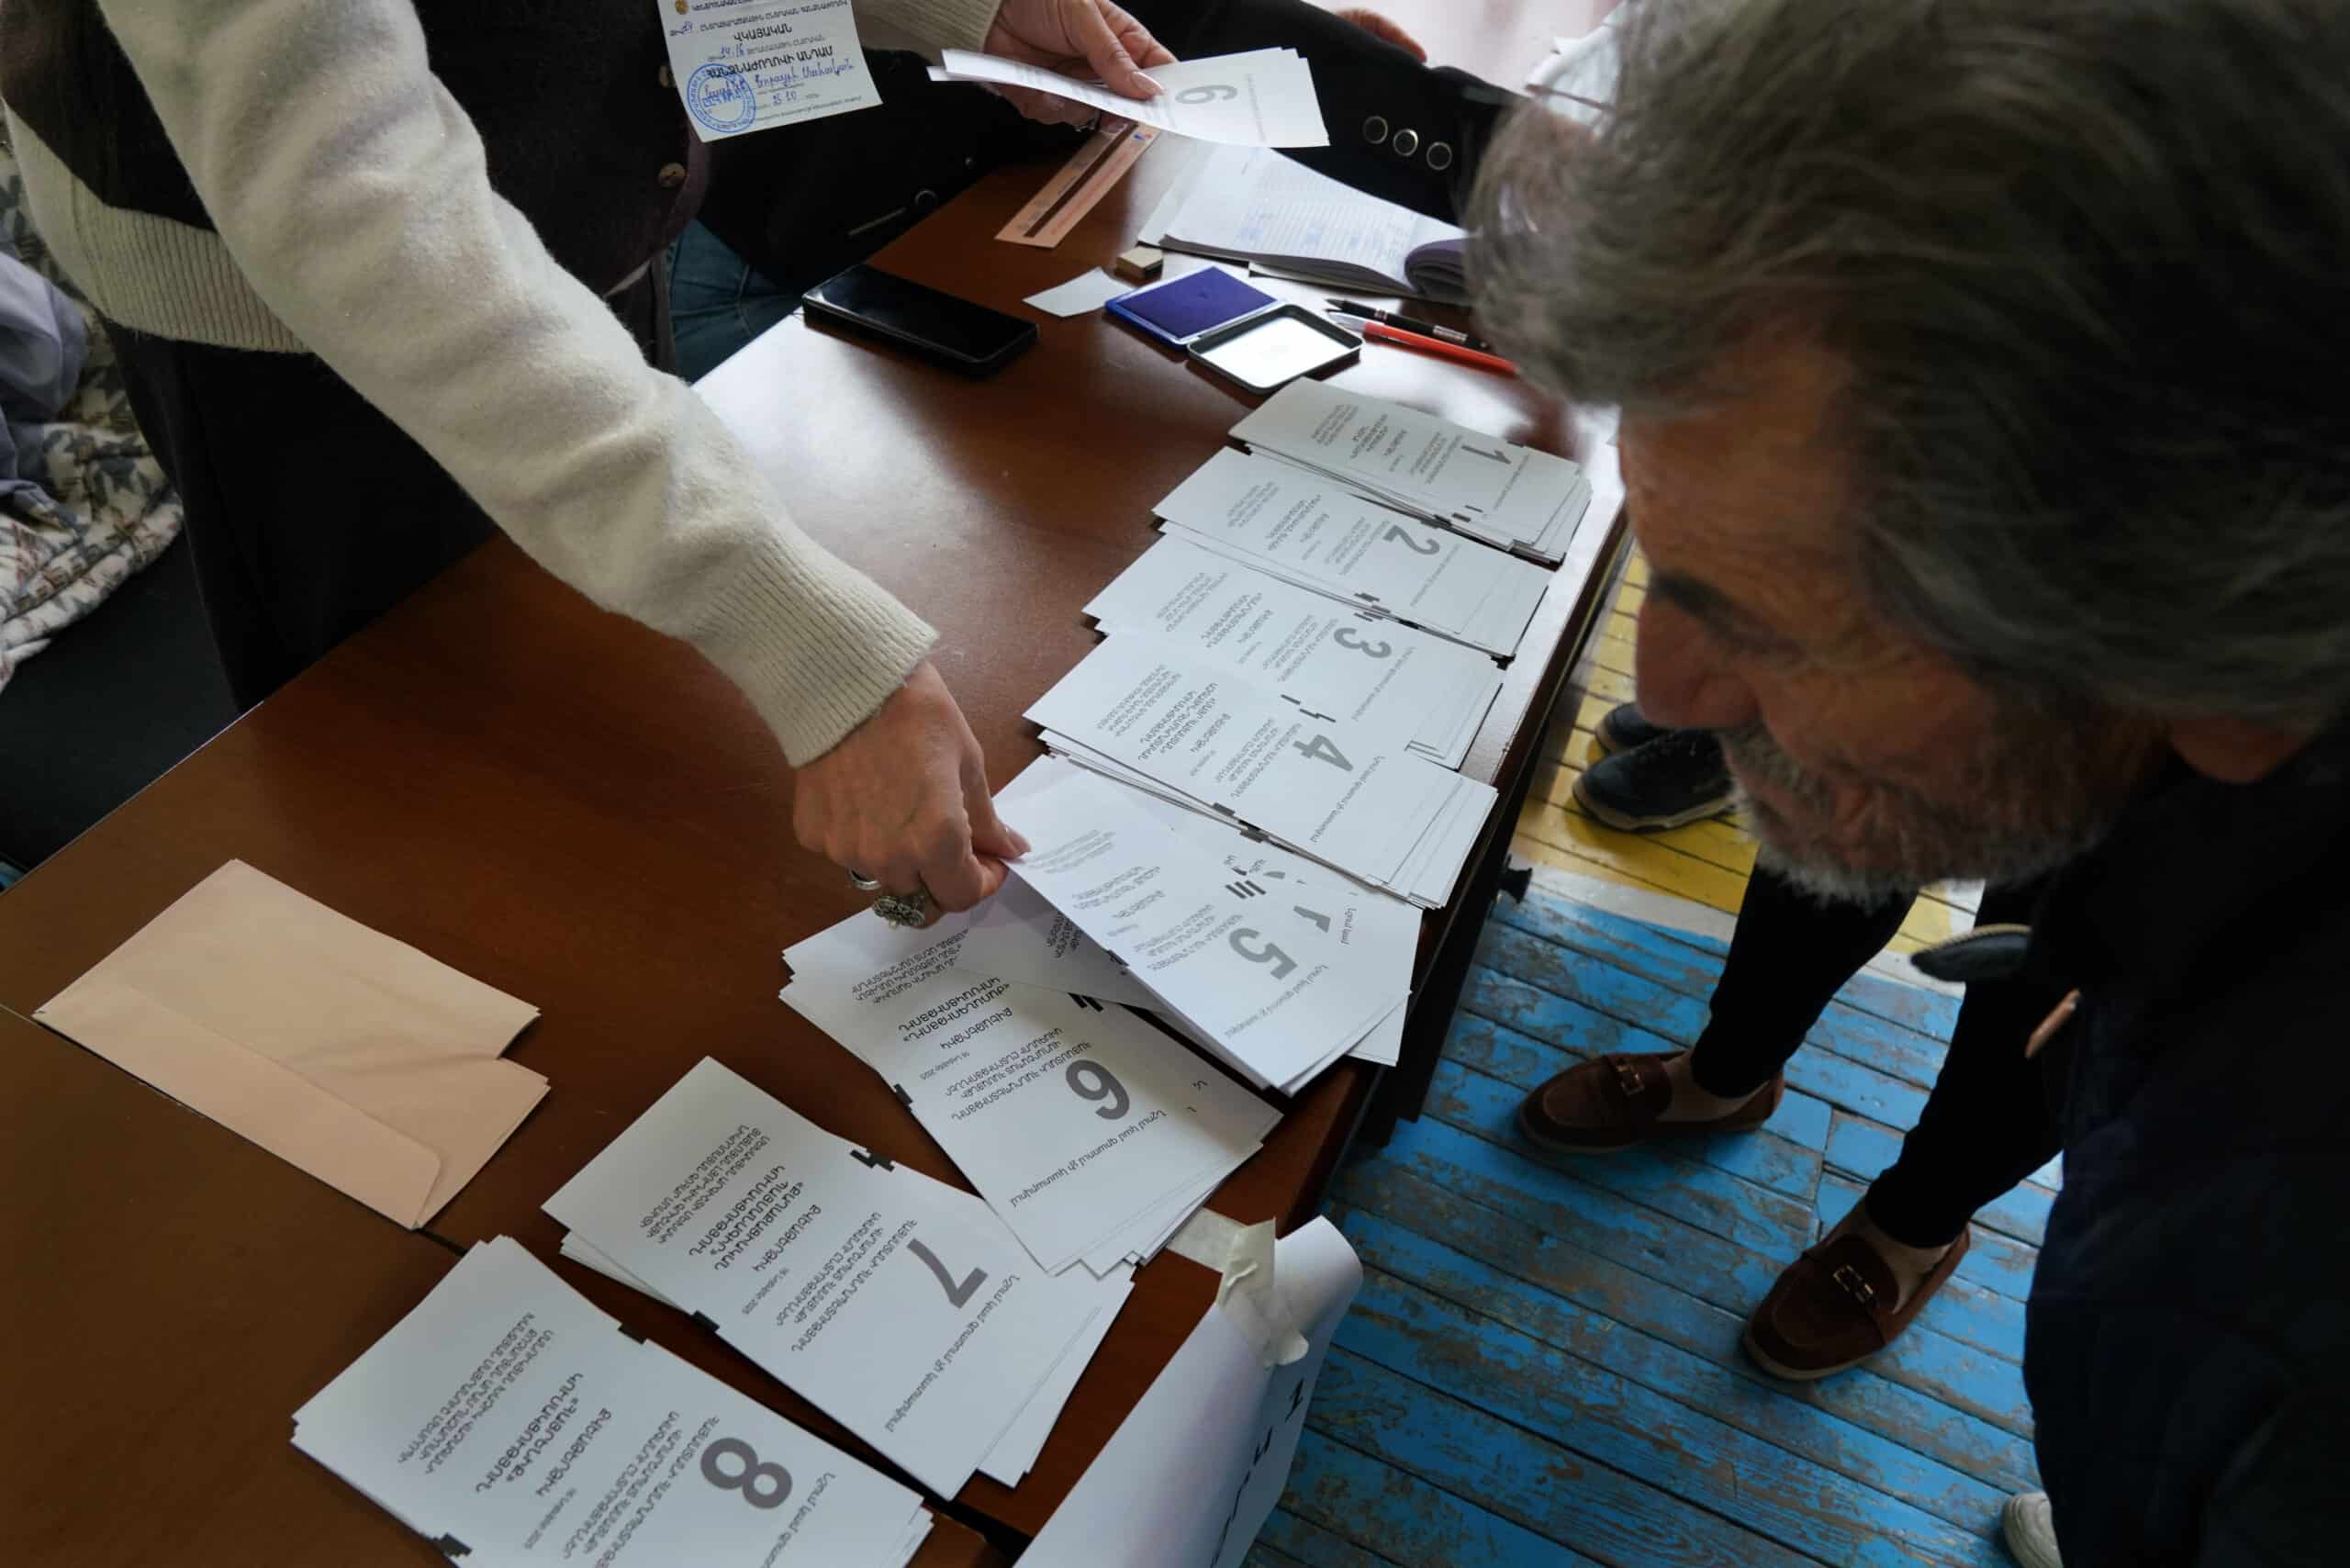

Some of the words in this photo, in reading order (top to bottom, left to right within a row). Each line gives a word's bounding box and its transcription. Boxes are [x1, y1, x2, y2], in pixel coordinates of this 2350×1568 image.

[733, 23, 793, 41] ՎԿԱՅԱԿԱՆ
[798, 45, 834, 62] ԱՆԴԱՄ
[1460, 445, 1511, 465] 1
[1383, 524, 1440, 555] 2
[1334, 627, 1392, 658] 3
[1293, 734, 1353, 772] 4
[1229, 927, 1298, 980] 5
[898, 976, 1001, 1031] ԿՈՒՍԱԿՑՈՒԹՅՈՒՆ
[903, 982, 1011, 1042] «ԺԱՌԱՆԳՈՒԹՅՈՒՆ»
[940, 1003, 1013, 1049] ՔՎԵԱԹԵՐԹԻԿ
[1065, 1058, 1130, 1120] 6
[1138, 1103, 1169, 1130] Նշում
[688, 1165, 786, 1256] ԿՈՒՍԱԿՑՈՒԹՅՈՒՆ
[710, 1182, 789, 1255] ՊԱՅՄԱՆԱԳԻՐ»
[714, 1182, 803, 1271] «ՔԱՂԱՔԱՑԻԱԿԱՆ
[752, 1204, 822, 1271] ՔՎԵԱԹԵՐԹԻԿ
[869, 1220, 917, 1269] ՀԱՅԱՍՏԱՆԻ
[907, 1238, 989, 1309] 7
[993, 1274, 1021, 1304] Նշում
[791, 1269, 873, 1351] ՀԱՆՐԱՊԵՏՈՒԹՅՈՒՆ
[977, 1301, 998, 1323] կամ
[944, 1321, 979, 1364] գրառում
[884, 1372, 938, 1433] կատարվում
[476, 1372, 584, 1493] ԿՈՒՍԱԿՑՈՒԹՅՈՒՆ
[506, 1397, 578, 1482] «ՀԱՅՐԵՆԻՔ»
[535, 1407, 611, 1496] ՔՎԵԱԹԵՐԹԻԿ
[636, 1411, 679, 1464] ԱՎԱԳԱՆՈՒ
[667, 1417, 720, 1479] ՀԱՅԱՍՏԱՆԻ
[700, 1437, 792, 1509] 8
[807, 1471, 836, 1507] Նշում
[564, 1463, 638, 1559] ԸՆՏՐՈՒԹՅՈՒՆՆԵՐ
[789, 1504, 812, 1535] կամ
